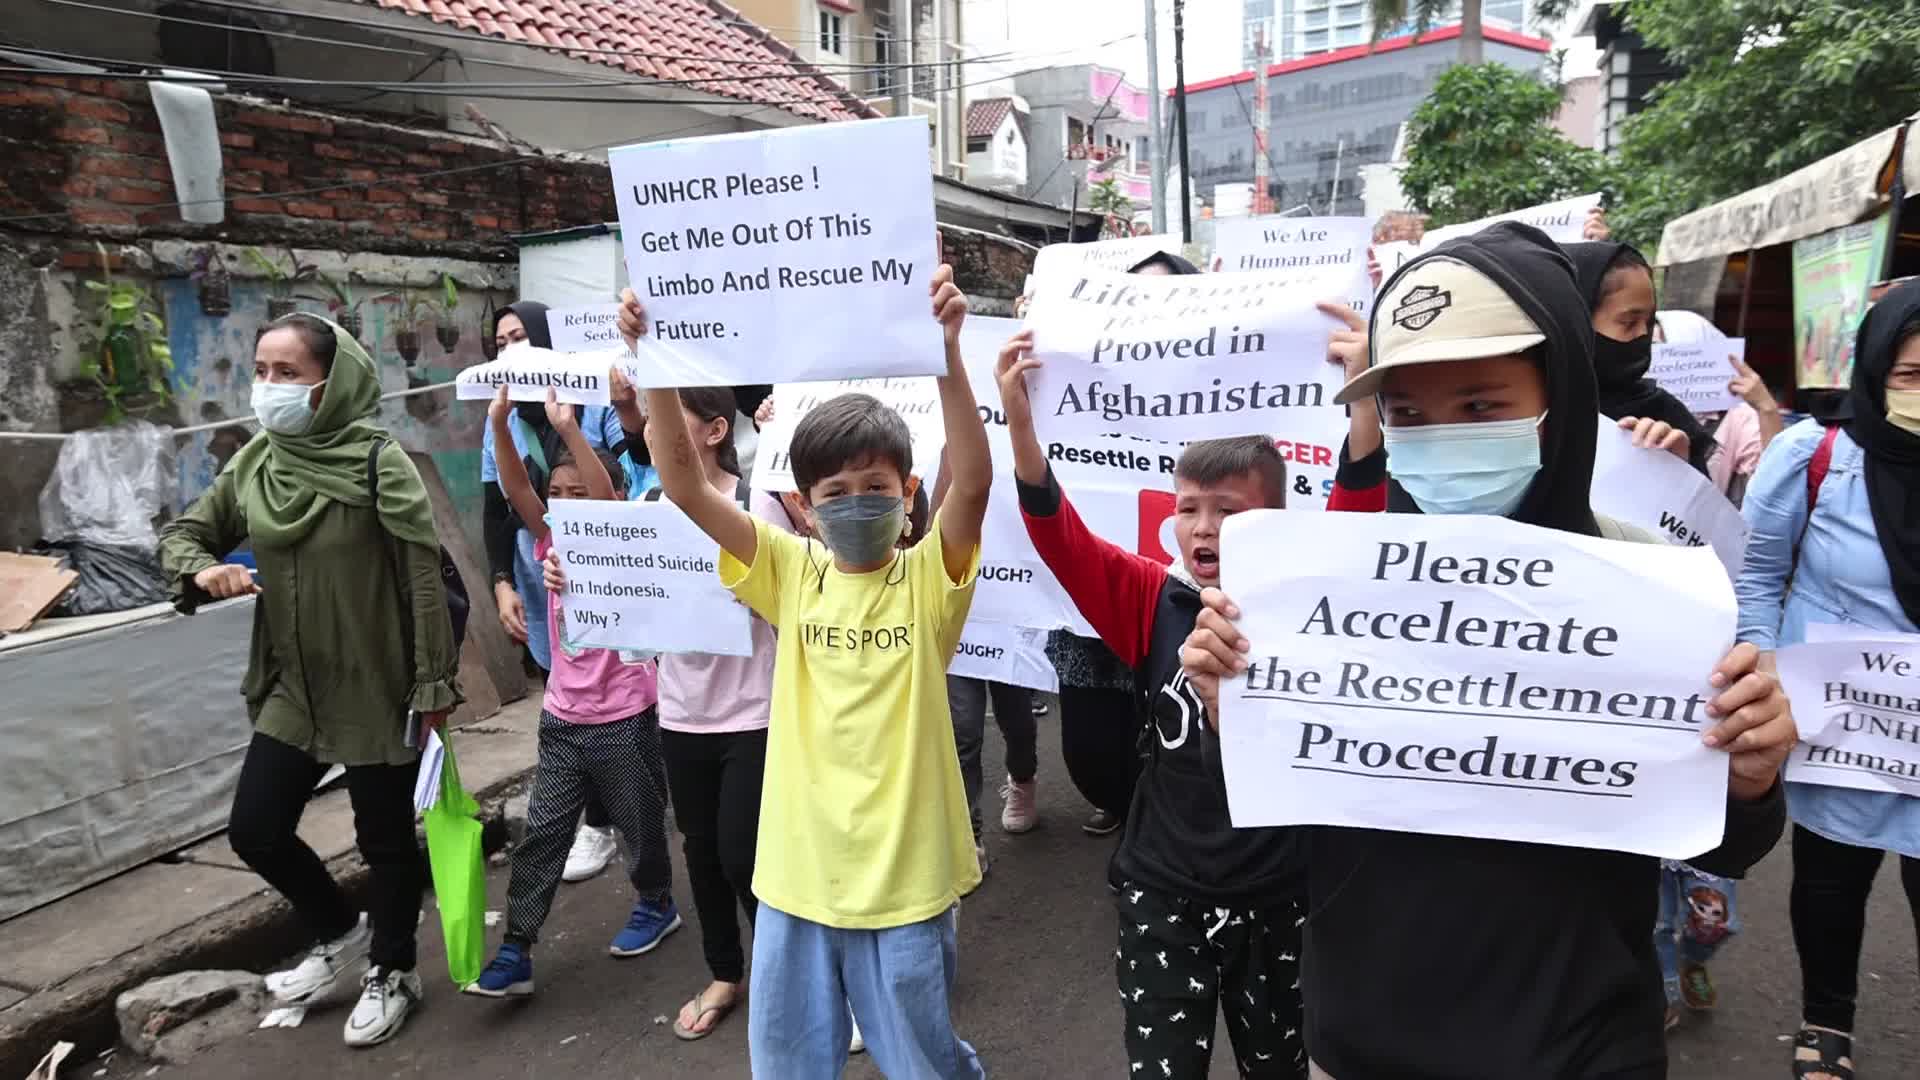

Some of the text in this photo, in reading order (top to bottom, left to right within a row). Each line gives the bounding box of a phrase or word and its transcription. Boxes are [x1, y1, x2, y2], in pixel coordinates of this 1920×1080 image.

[633, 166, 820, 206] UNHCR Please !
[641, 213, 871, 254] Get Me Out Of This
[1263, 228, 1328, 243] We Are
[1240, 248, 1352, 269] Human and
[648, 258, 914, 298] Limbo And Rescue My
[565, 312, 618, 326] Refugee
[655, 317, 725, 341] Future
[584, 328, 624, 342] Seeki
[1091, 325, 1265, 364] Proved in
[1660, 347, 1704, 358] Please
[1652, 360, 1718, 374] ccelerate
[1054, 378, 1323, 421] Afghanistan
[1049, 442, 1151, 472] Resettle
[1273, 440, 1332, 466] GER
[1294, 475, 1313, 496] &
[562, 521, 657, 541] 14 Refugees
[1660, 511, 1688, 540] We
[567, 550, 714, 573] Committed Suicide
[976, 565, 1033, 583] UGH?
[1373, 541, 1554, 587] Please
[570, 580, 670, 599] In Indonesia.
[574, 609, 621, 628] Why ?
[1298, 595, 1618, 657] Accelerate
[956, 642, 1004, 660] OUGH?
[1861, 652, 1911, 677] We
[1245, 655, 1708, 724] the Resettlement
[1824, 682, 1920, 712] Huma
[1843, 713, 1920, 744] UNH
[1295, 721, 1638, 789] Procedures
[1806, 745, 1920, 777] Huma
